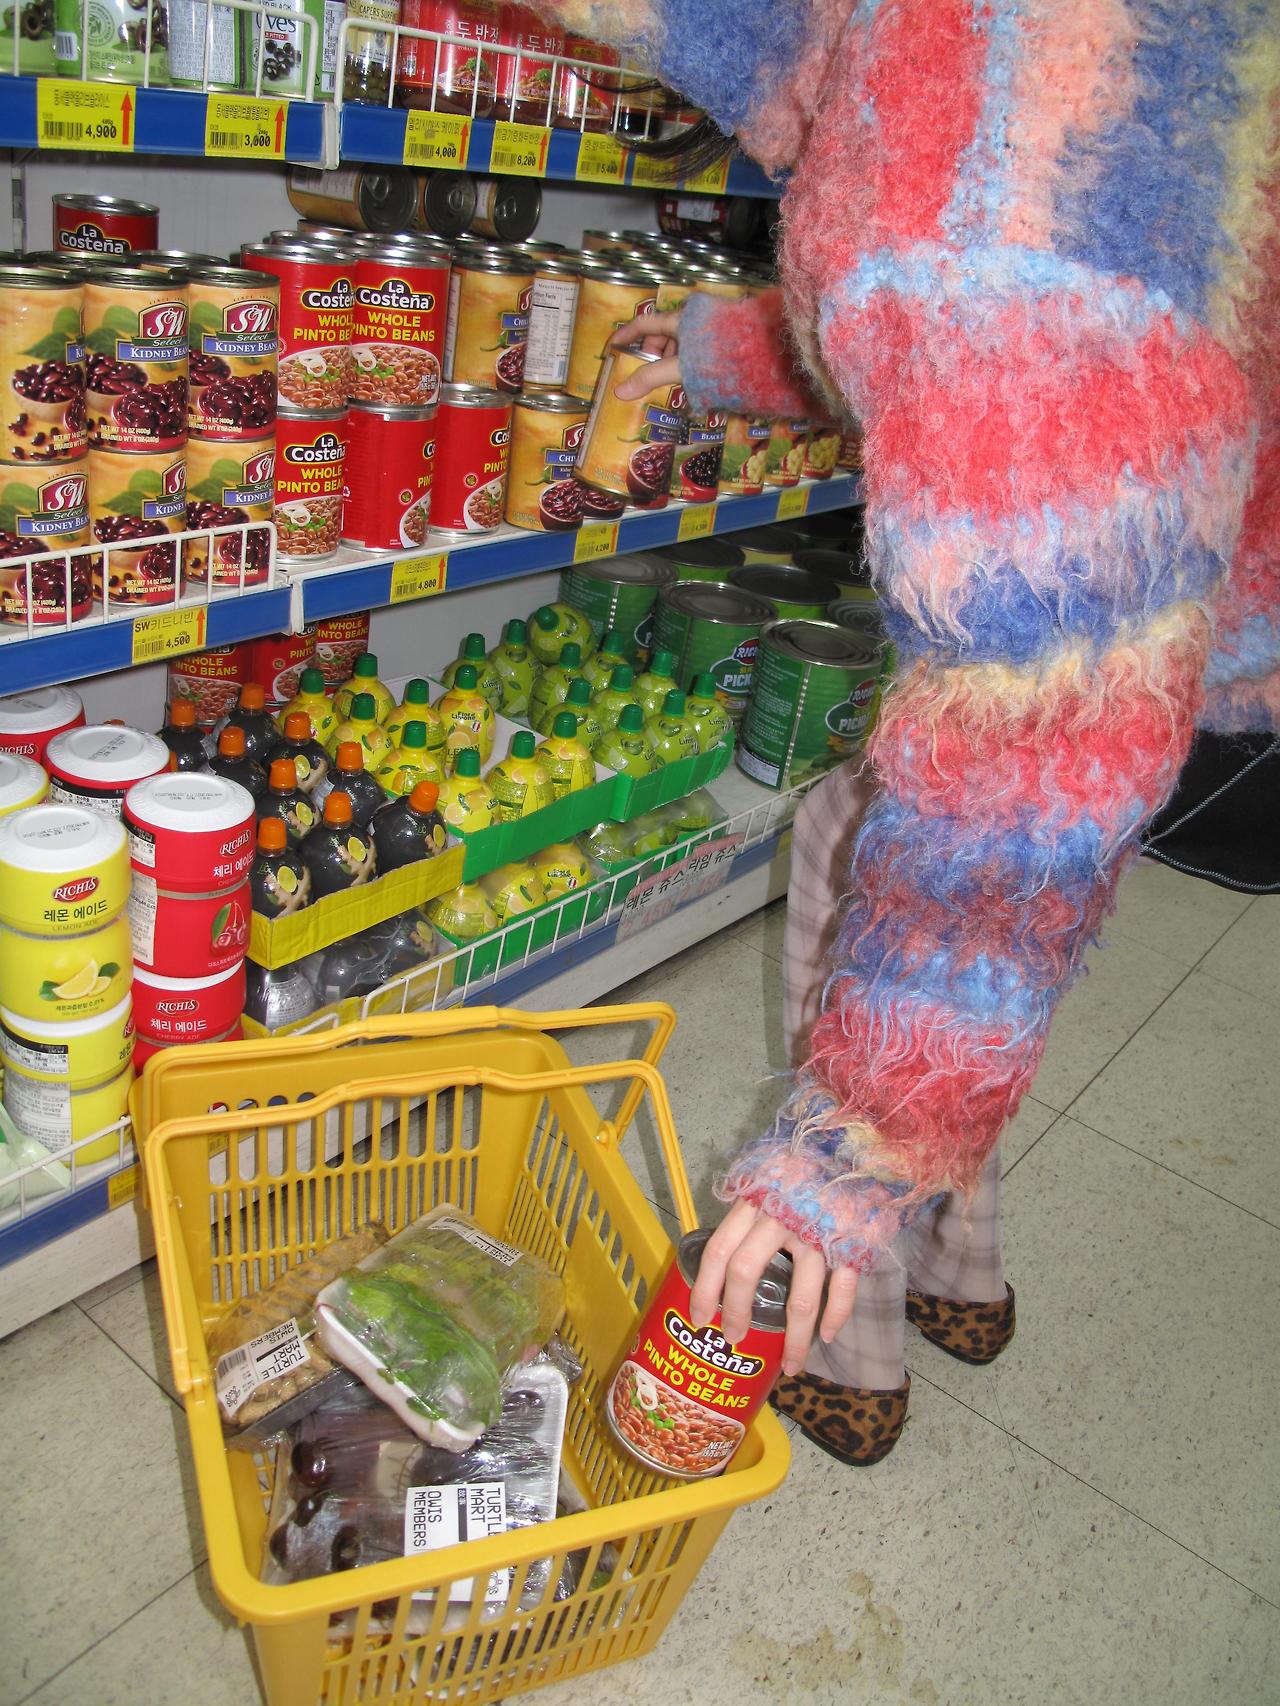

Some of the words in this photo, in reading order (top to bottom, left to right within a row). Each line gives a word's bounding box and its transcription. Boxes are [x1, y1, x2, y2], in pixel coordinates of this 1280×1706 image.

[85, 124, 117, 139] 4,900
[435, 146, 457, 158] 4,000
[82, 226, 97, 239] La
[60, 231, 125, 254] Costeña
[337, 282, 348, 293] La
[388, 282, 405, 294] La
[360, 289, 431, 309] Costeña
[147, 307, 186, 338] S&W
[230, 304, 274, 333] S&W
[367, 311, 421, 328] WHOLE
[153, 338, 182, 347] Select
[235, 332, 268, 342] Select
[293, 328, 336, 341] PINTO
[392, 329, 435, 342] BEANS
[131, 347, 172, 358] KIDNEY
[215, 342, 256, 353] KIDNEY
[321, 436, 334, 448] La
[300, 464, 343, 480] WHOLE
[277, 480, 321, 493] PINTO
[47, 480, 84, 511] S&W
[236, 491, 268, 503] KIDNEY
[54, 508, 84, 520] Select
[32, 520, 74, 532] KIDNEY
[417, 578, 437, 590] 4,800
[329, 619, 363, 630] WHOLE
[165, 634, 191, 649] 4,500
[200, 666, 238, 676] BEANS
[220, 830, 251, 857] RICHIS
[213, 863, 233, 878] 체리
[235, 850, 254, 871] 에이드
[689, 853, 713, 871] 라임
[54, 877, 98, 901] RICHIS
[44, 909, 69, 922] 레몬
[73, 900, 108, 919] 에이드
[157, 1000, 197, 1015] RICHIS
[151, 1017, 172, 1032] 체리
[175, 1019, 207, 1033] 에이드
[250, 1321, 293, 1349] MEMBERS
[269, 1326, 295, 1344] OWIS
[703, 1328, 726, 1350] La
[273, 1340, 300, 1364] MART
[668, 1316, 755, 1375] Costeña
[261, 1350, 305, 1380] TURTLE
[668, 1344, 736, 1392] WHOLE
[643, 1338, 685, 1386] PINTO
[687, 1380, 751, 1409] BEANS
[427, 1490, 442, 1524] OWIS
[470, 1488, 486, 1523] MART
[413, 1491, 428, 1547] MEMBERS
